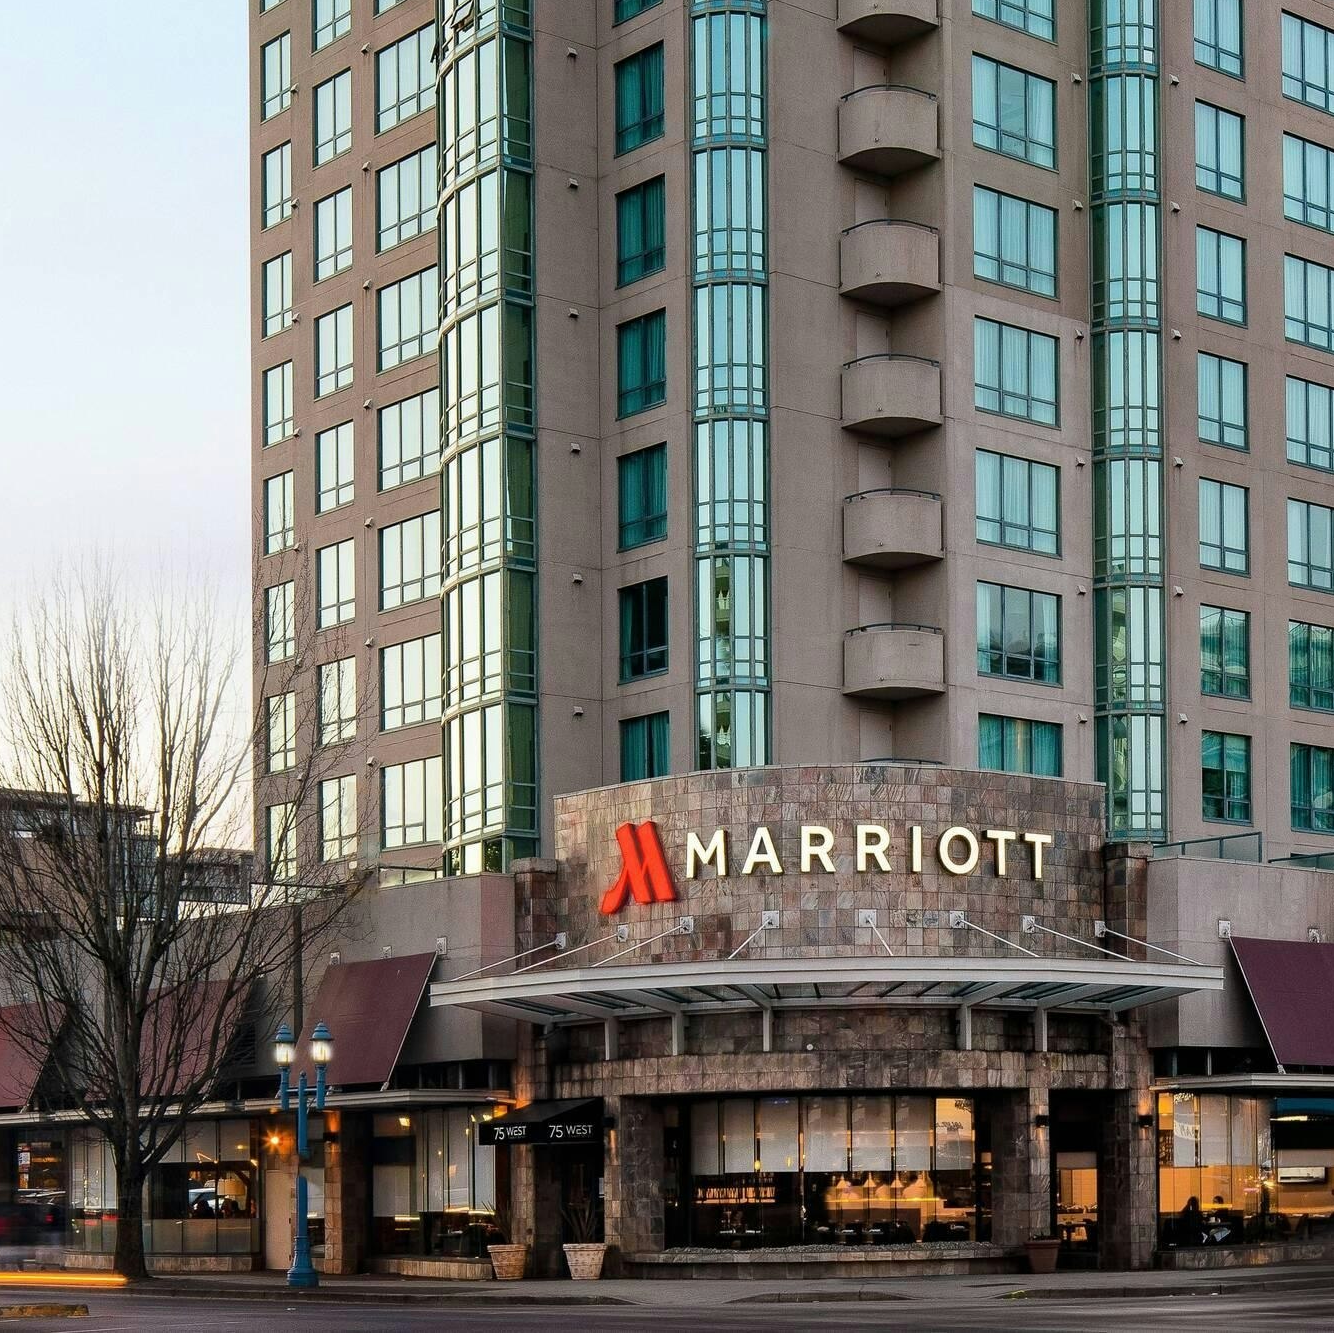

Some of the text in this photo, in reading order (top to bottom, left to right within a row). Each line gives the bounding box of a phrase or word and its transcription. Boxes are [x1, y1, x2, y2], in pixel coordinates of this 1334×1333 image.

[685, 824, 1052, 880] MARRIOTT
[494, 1127, 505, 1140] 75
[548, 1125, 564, 1138] 75
